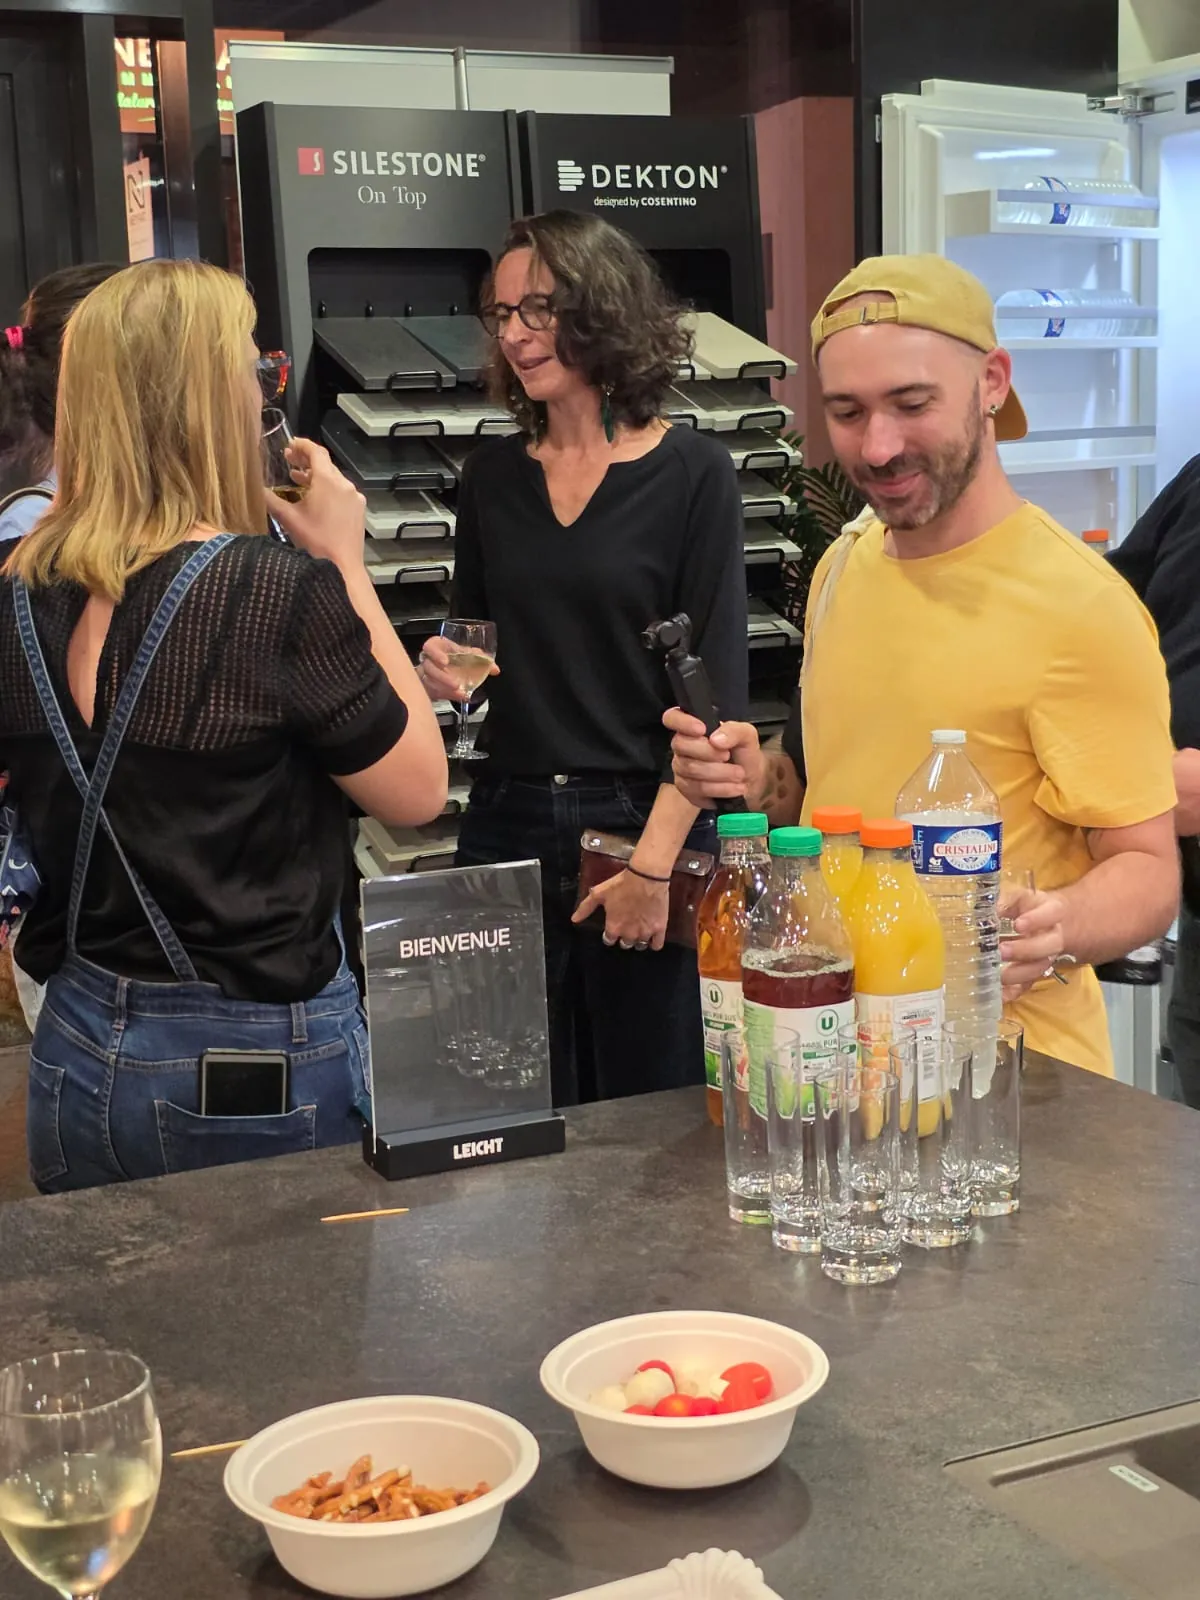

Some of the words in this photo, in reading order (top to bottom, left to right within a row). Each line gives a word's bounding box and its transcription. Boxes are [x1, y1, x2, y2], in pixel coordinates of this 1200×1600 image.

[357, 185, 387, 204] On
[392, 186, 427, 210] Top
[594, 196, 629, 208] designed
[630, 196, 640, 208] by
[641, 197, 697, 206] COSENTINO
[400, 927, 511, 959] BIENVENUE
[821, 1016, 834, 1030] U
[453, 1137, 504, 1160] LEICHT
